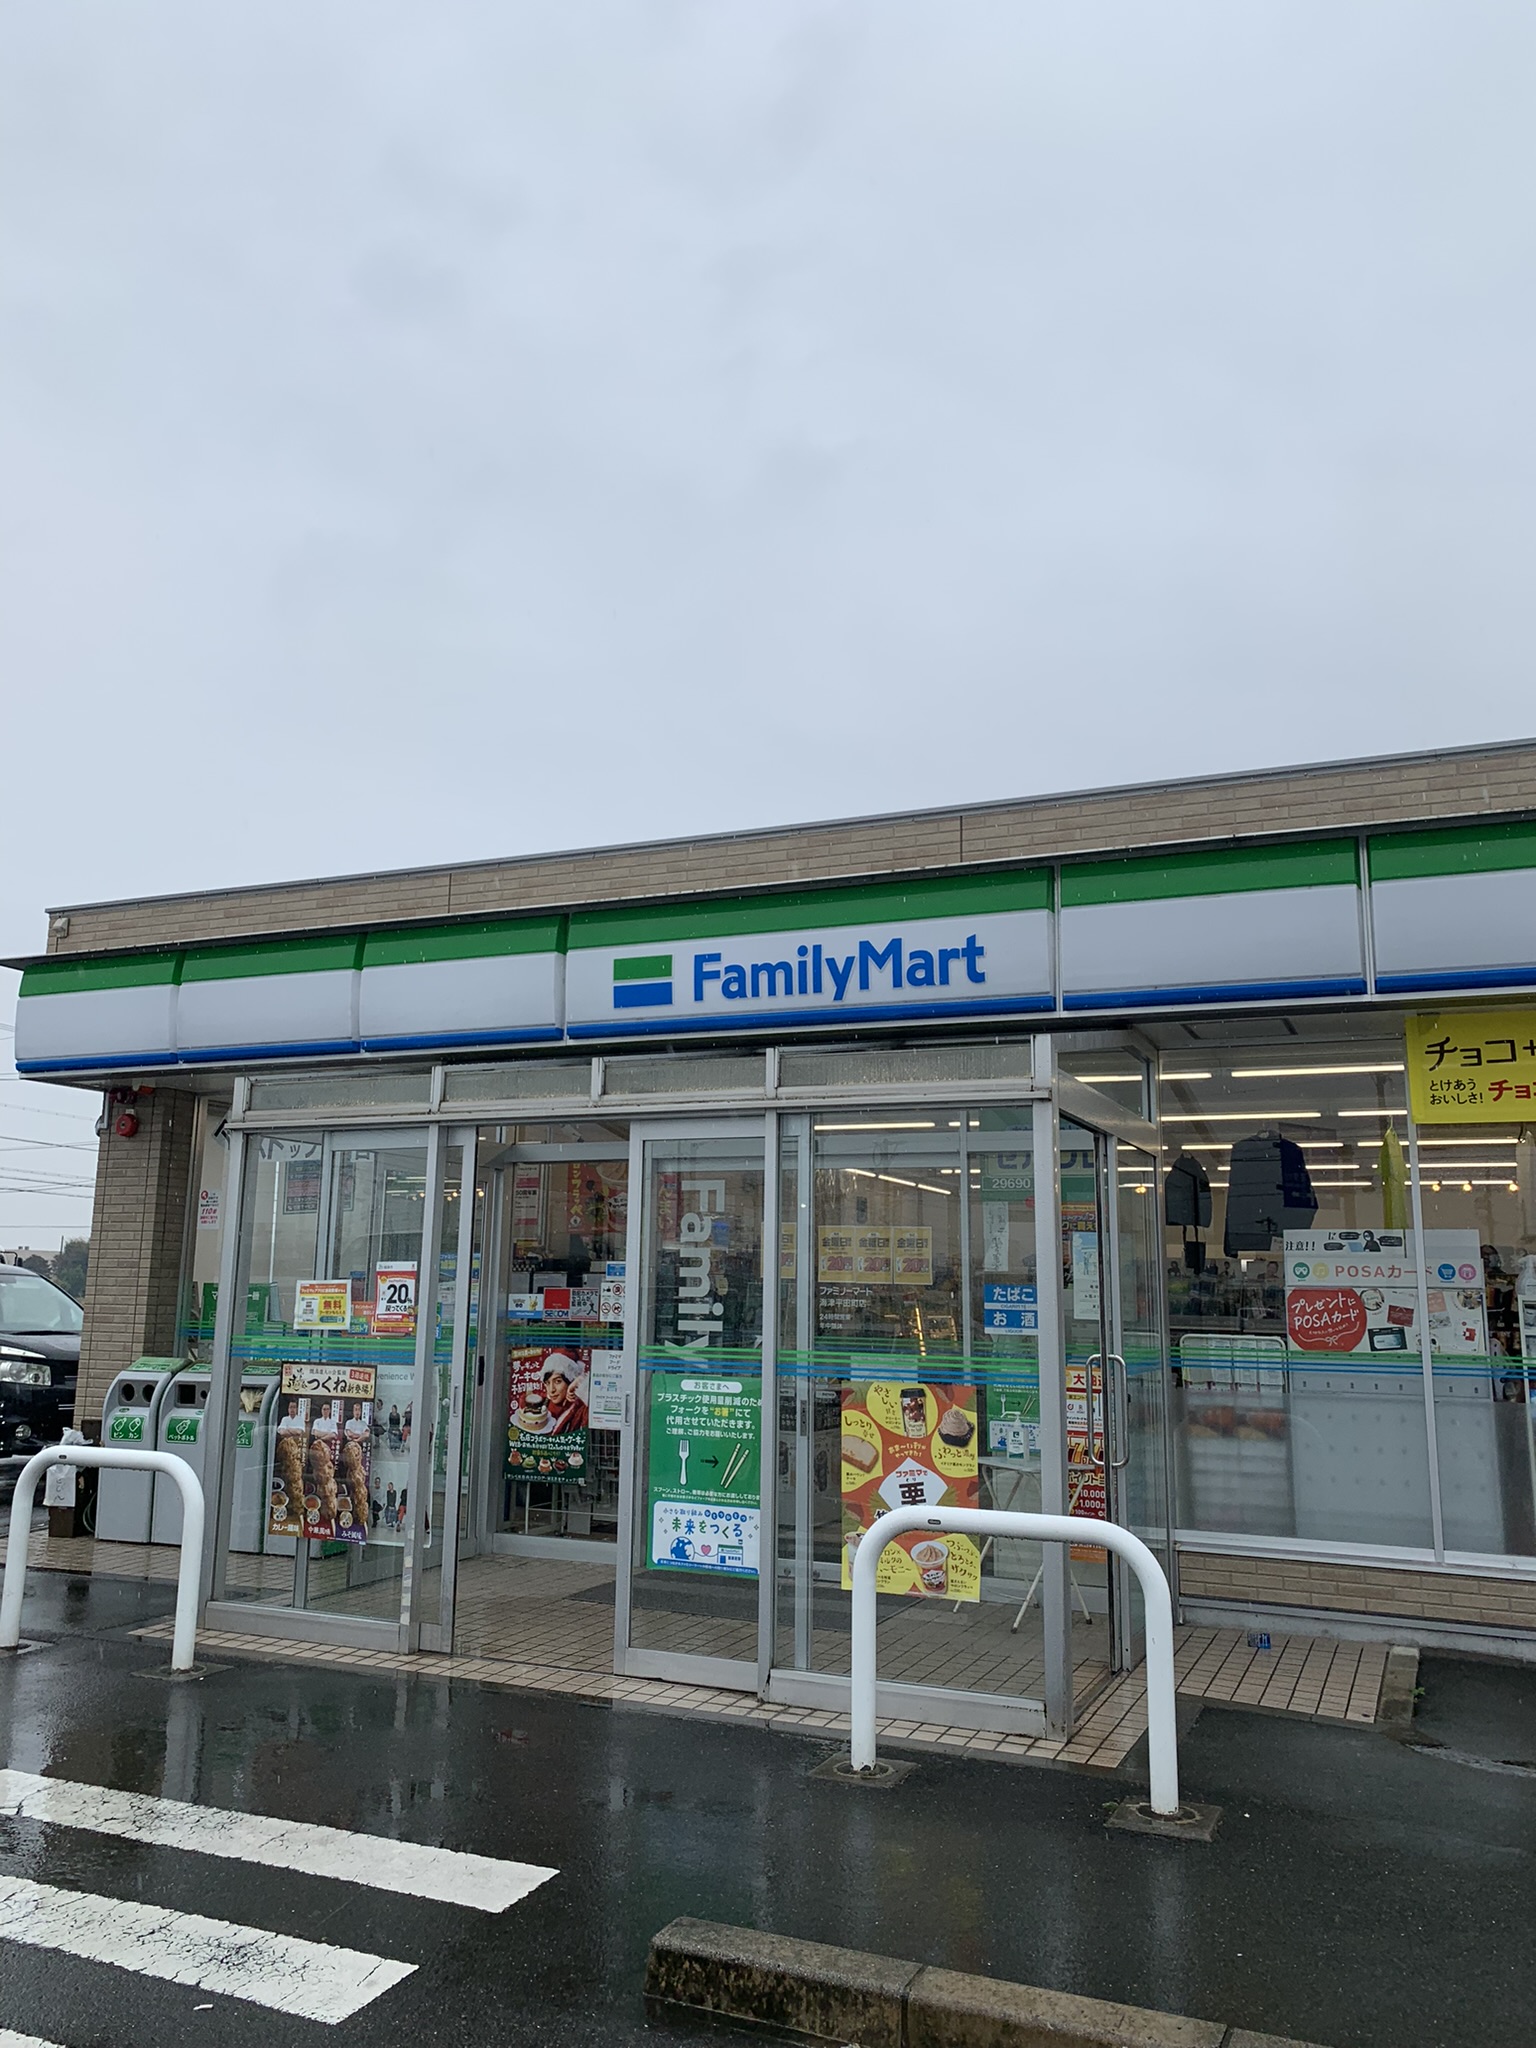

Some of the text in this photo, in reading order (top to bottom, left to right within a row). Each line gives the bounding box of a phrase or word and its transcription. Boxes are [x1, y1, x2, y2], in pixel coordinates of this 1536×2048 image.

[694, 933, 986, 1001] FamilyMart
[1429, 1078, 1476, 1092] とけあう
[1488, 1079, 1536, 1102] チョ
[1430, 1092, 1484, 1105] おいしさ!
[992, 1178, 1032, 1189] 29690
[993, 1286, 1034, 1302] たばこ
[384, 1304, 408, 1313] 戻ってくる
[1290, 1292, 1357, 1314] プレゼントに
[544, 1309, 570, 1318] SECOM
[1293, 1308, 1360, 1331] POSAカード
[693, 1381, 730, 1391] お客さまへ
[665, 1415, 756, 1430] 代用させていただきます。
[844, 1415, 872, 1431] しっとり
[112, 1431, 140, 1440] ビン カン
[167, 1433, 196, 1442] ペットボトル
[665, 1427, 756, 1440] ご理解、ご協力をお願いいたします。
[895, 1469, 928, 1479] ファミマで
[671, 1516, 743, 1539] 未来をつくる
